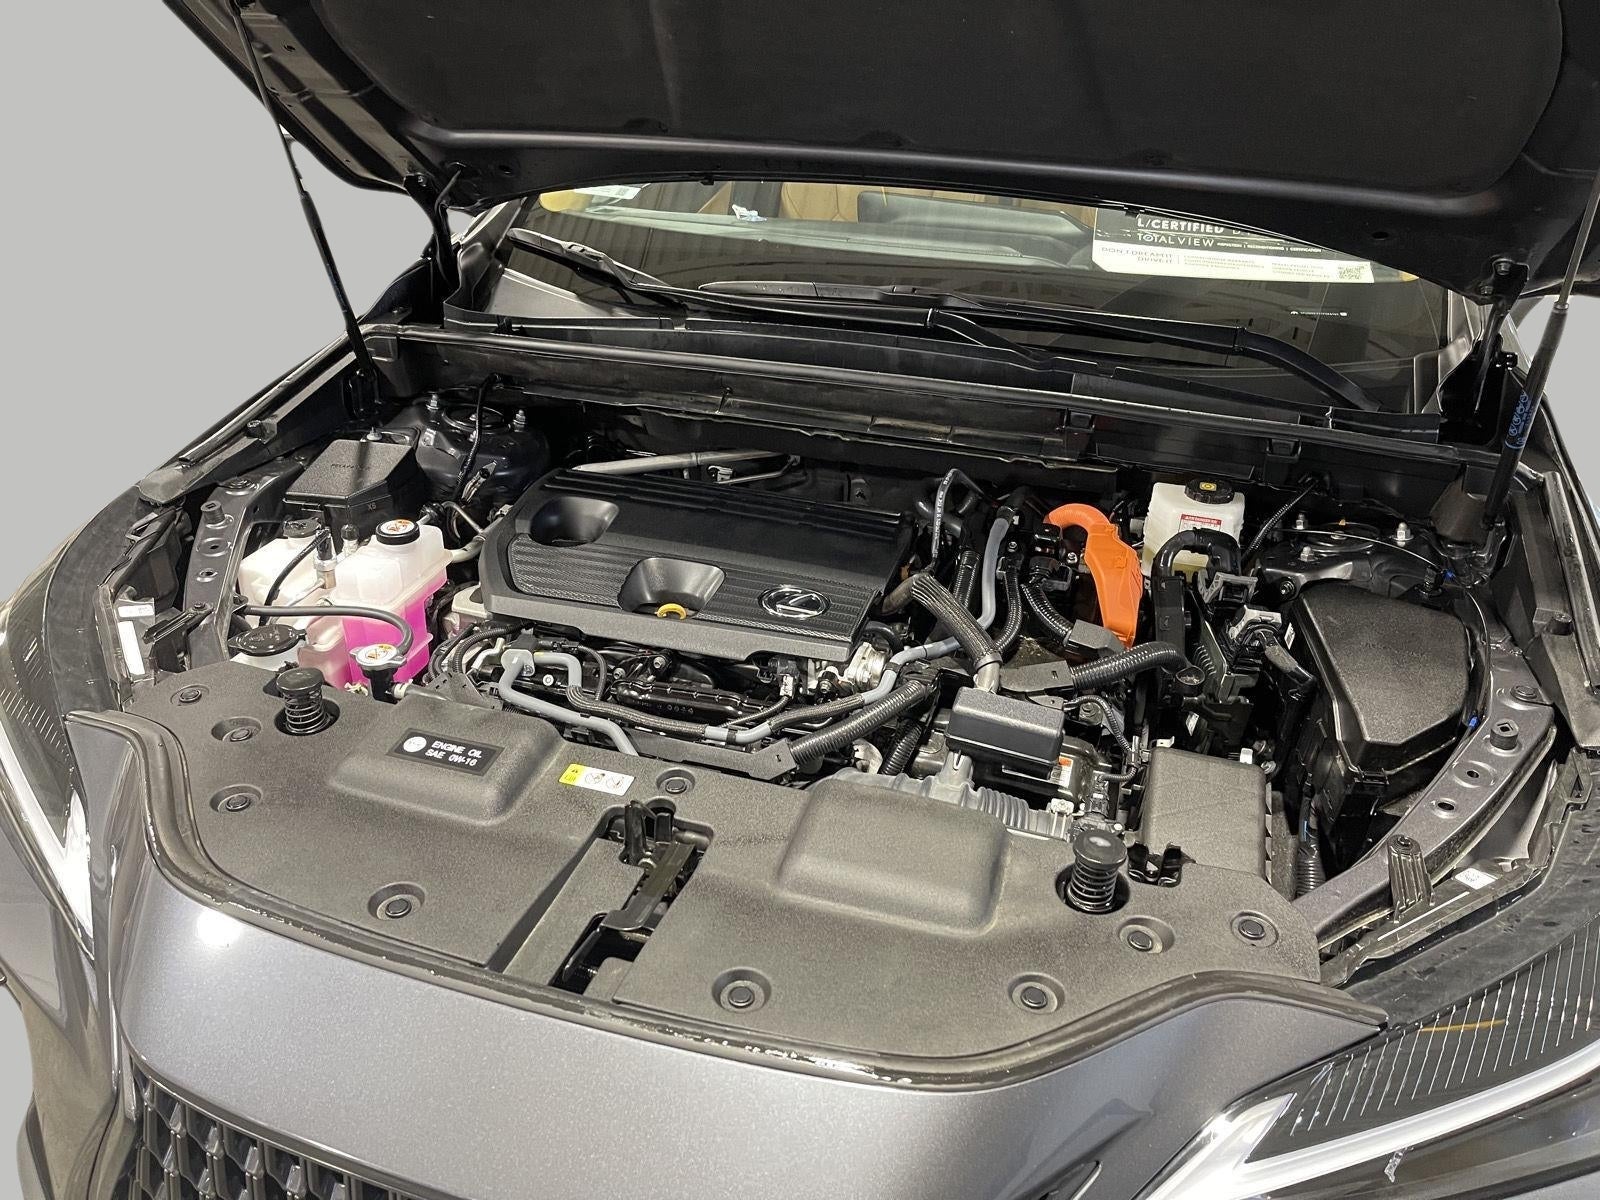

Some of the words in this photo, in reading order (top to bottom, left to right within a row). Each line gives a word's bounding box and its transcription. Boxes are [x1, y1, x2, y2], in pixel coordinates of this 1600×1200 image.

[1138, 233, 1174, 244] TOTAL
[1178, 236, 1215, 247] VIEW
[425, 748, 446, 759] SAE
[432, 741, 465, 753] ENGINE
[467, 749, 482, 758] OIL
